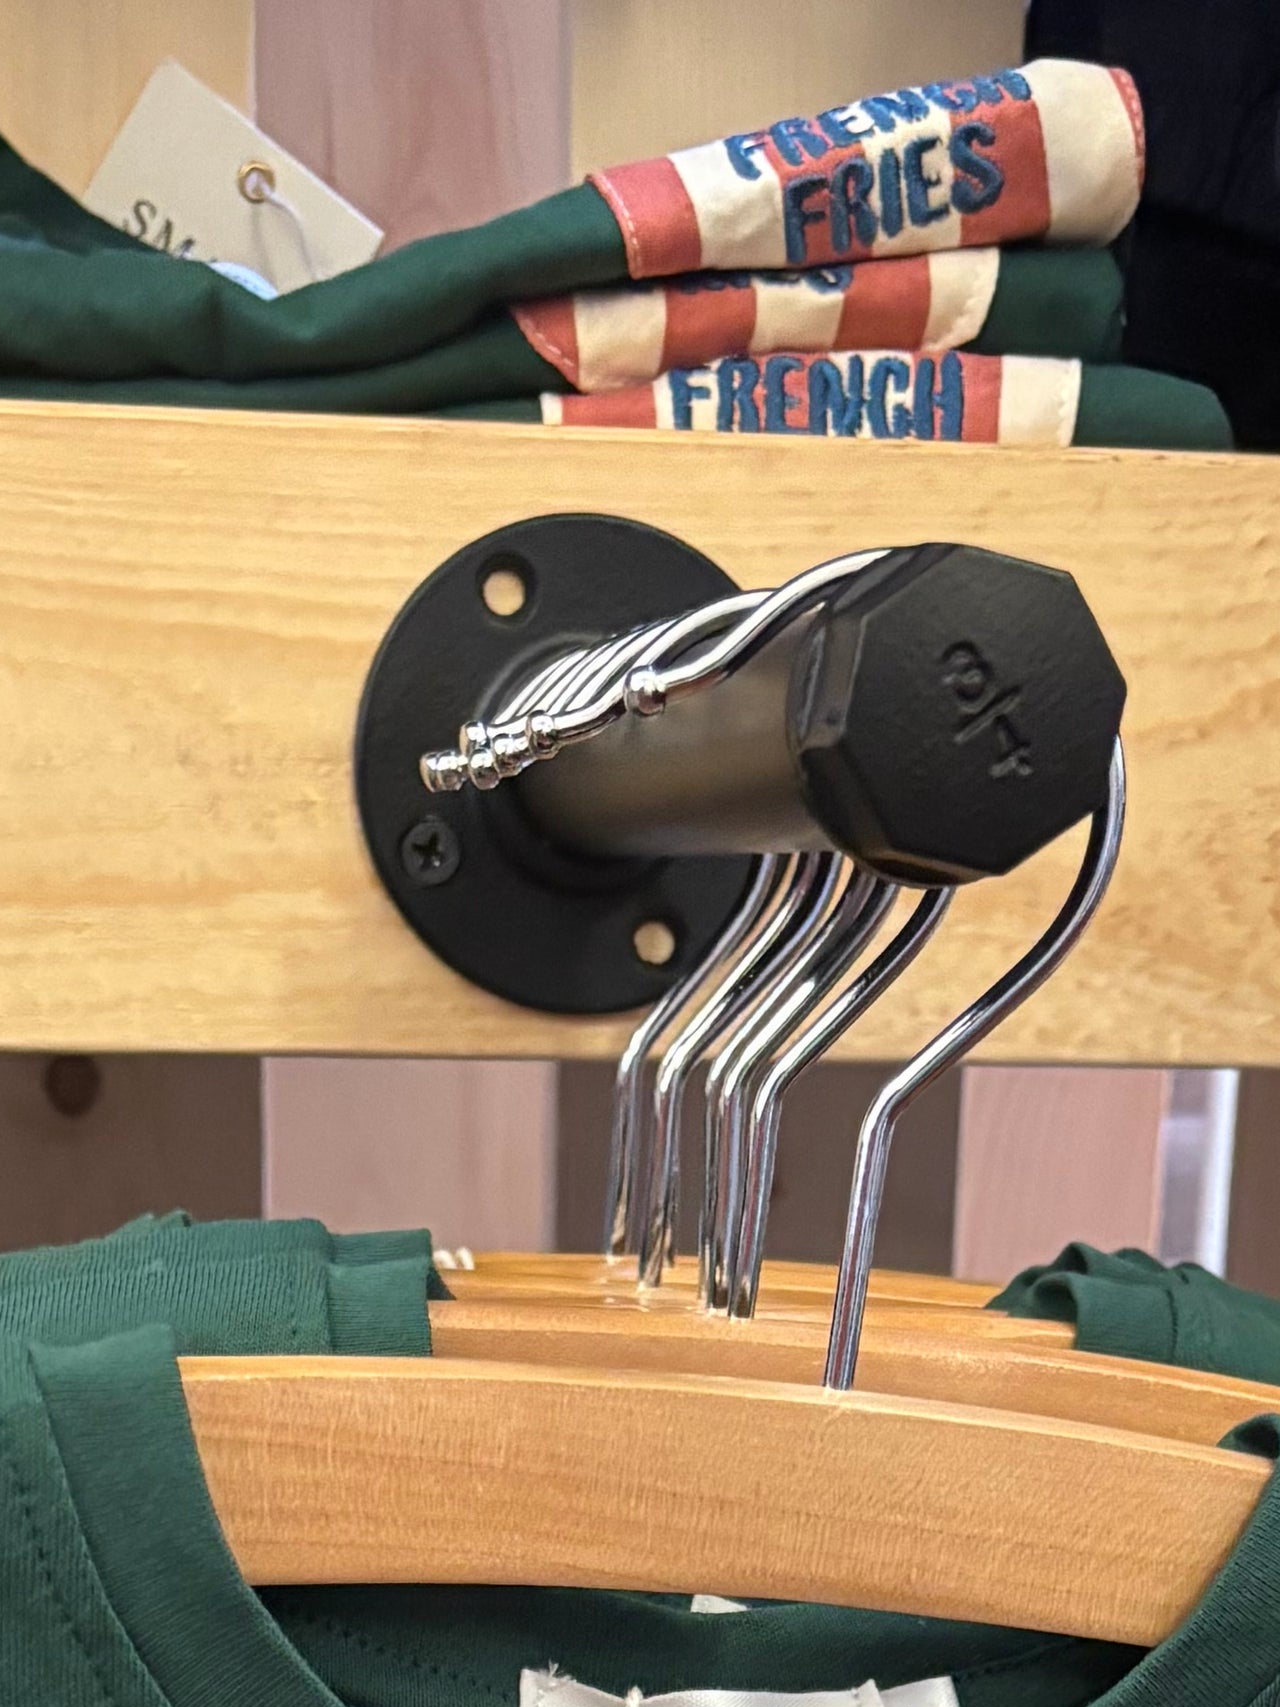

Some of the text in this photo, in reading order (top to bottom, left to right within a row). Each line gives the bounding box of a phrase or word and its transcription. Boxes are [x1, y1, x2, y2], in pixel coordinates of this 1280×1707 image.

[725, 67, 1031, 181] FRENCH
[783, 120, 1004, 264] FRIES
[670, 347, 963, 441] FRENCH
